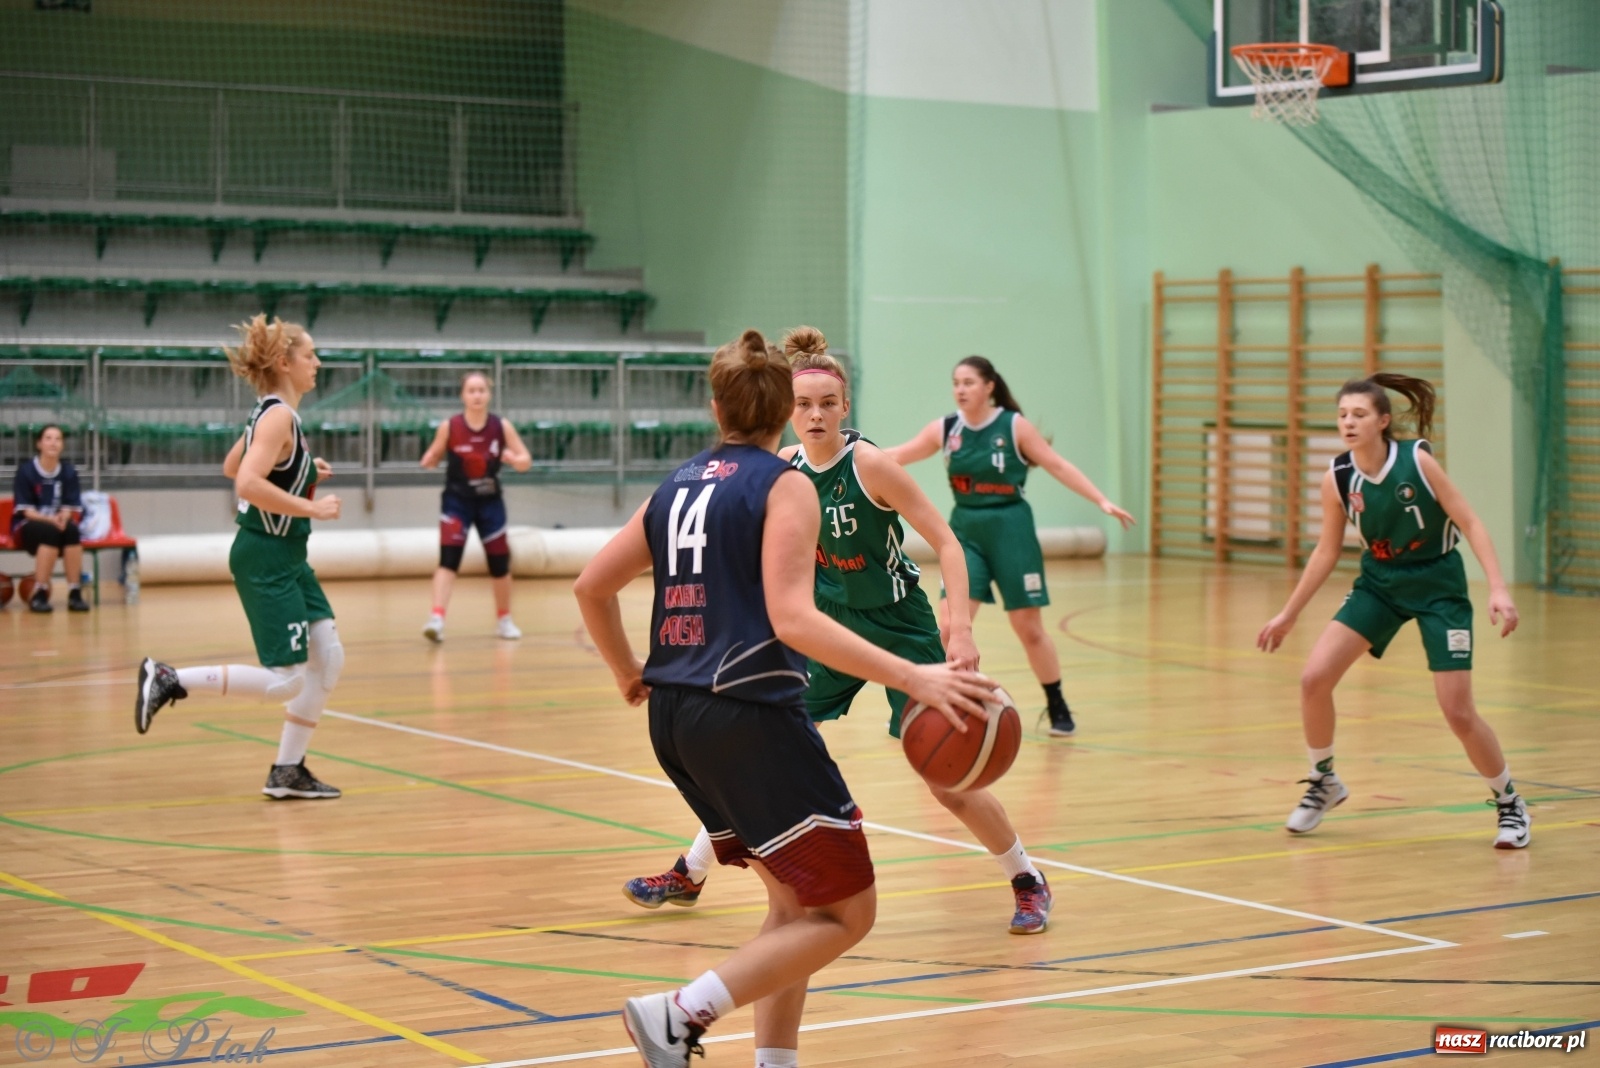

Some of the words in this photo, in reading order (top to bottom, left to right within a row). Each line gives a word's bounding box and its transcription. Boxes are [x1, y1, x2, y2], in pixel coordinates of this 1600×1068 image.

[991, 451, 1006, 474] 4
[667, 483, 717, 576] 14
[825, 503, 858, 539] 35
[659, 614, 705, 645] POLSKA
